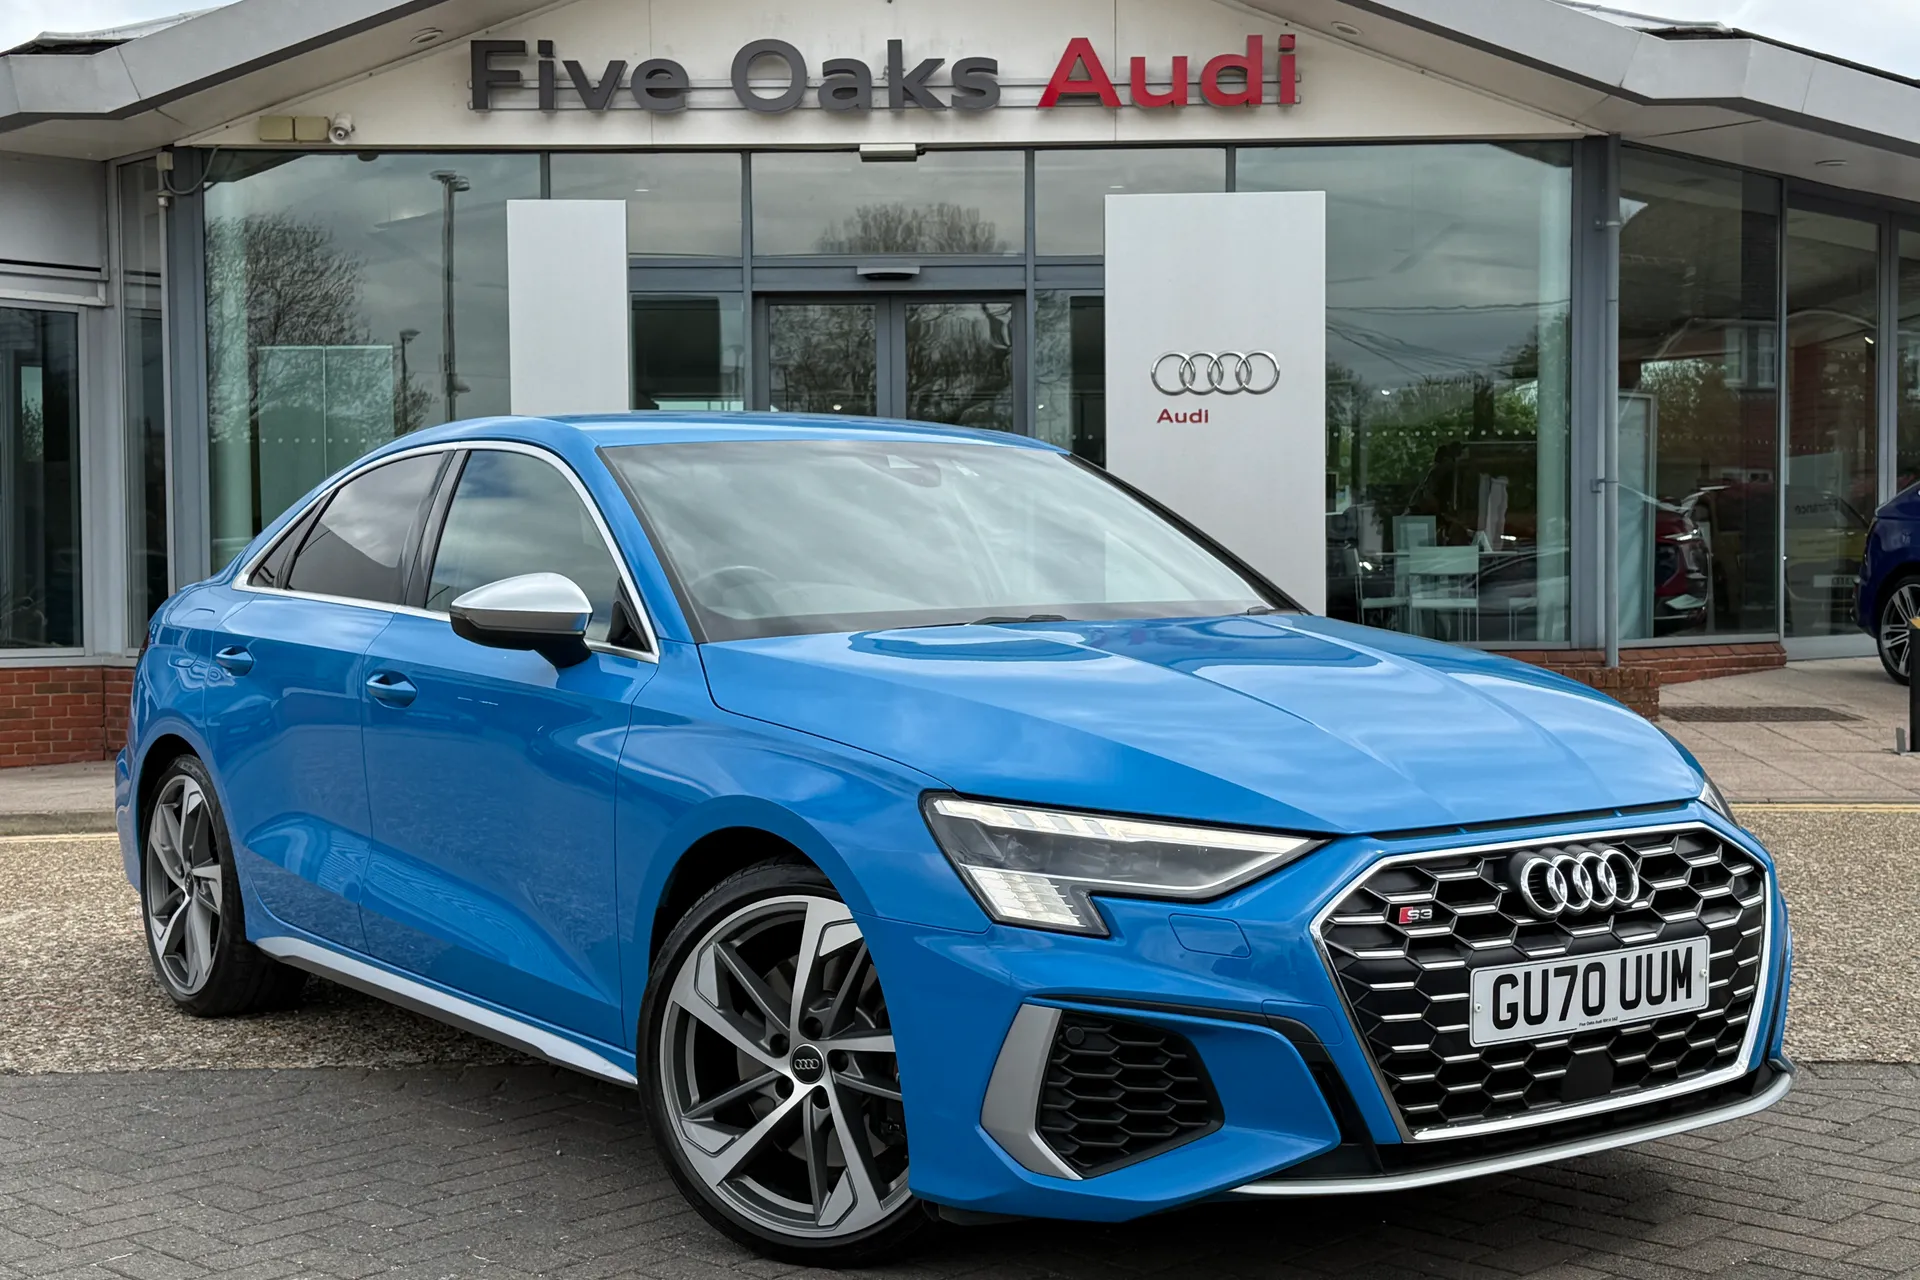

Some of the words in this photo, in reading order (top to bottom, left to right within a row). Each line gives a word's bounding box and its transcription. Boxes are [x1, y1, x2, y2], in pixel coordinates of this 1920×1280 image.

[470, 39, 691, 113] Five
[731, 38, 1001, 114] Oaks
[1037, 34, 1296, 109] Audi
[1157, 408, 1209, 424] Audi
[1406, 908, 1433, 920] S3
[1492, 961, 1606, 1030] GU70
[1619, 946, 1693, 1011] UUM
